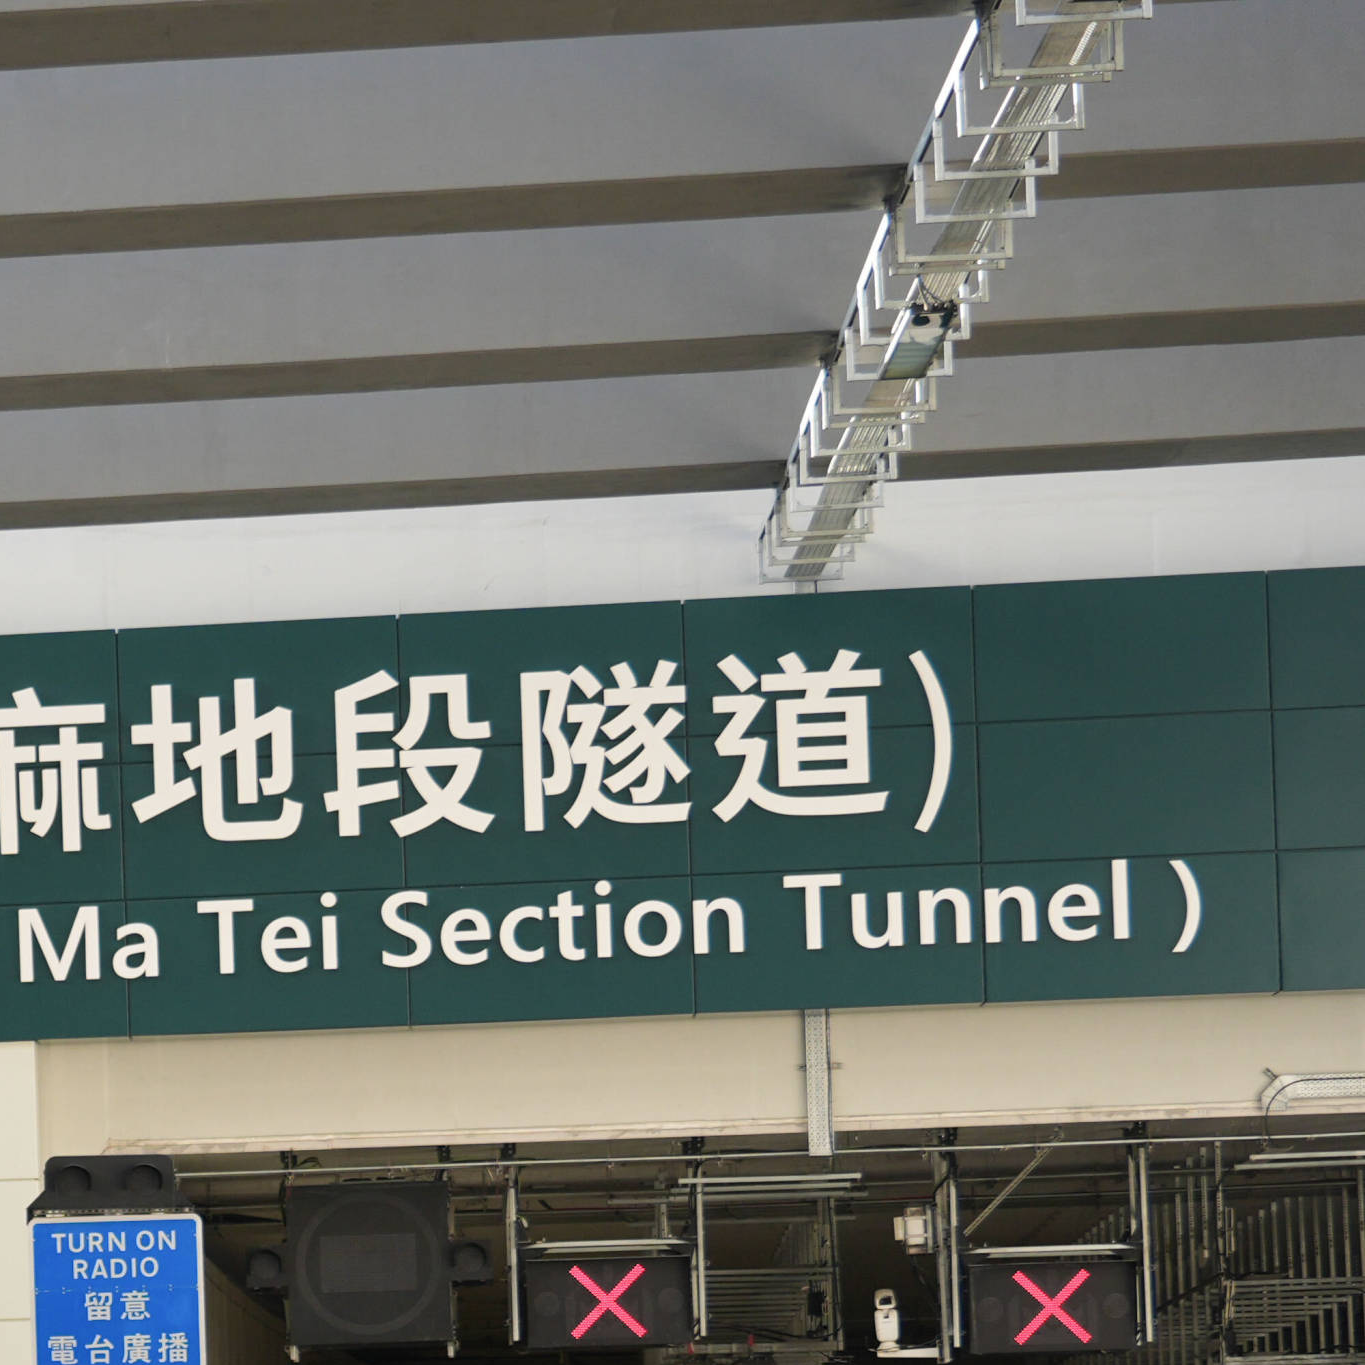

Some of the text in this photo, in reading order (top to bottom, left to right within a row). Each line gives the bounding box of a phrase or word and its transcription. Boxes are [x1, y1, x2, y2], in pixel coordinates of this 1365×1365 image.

[18, 905, 160, 983] Ma
[196, 891, 339, 975] Tei
[380, 881, 745, 968] Section
[782, 858, 1130, 950] Tunnel
[51, 1229, 177, 1254] TURN ON
[72, 1256, 159, 1280] RADIO
[84, 1290, 151, 1321] 留意
[47, 1332, 189, 1365] 電台廣播
